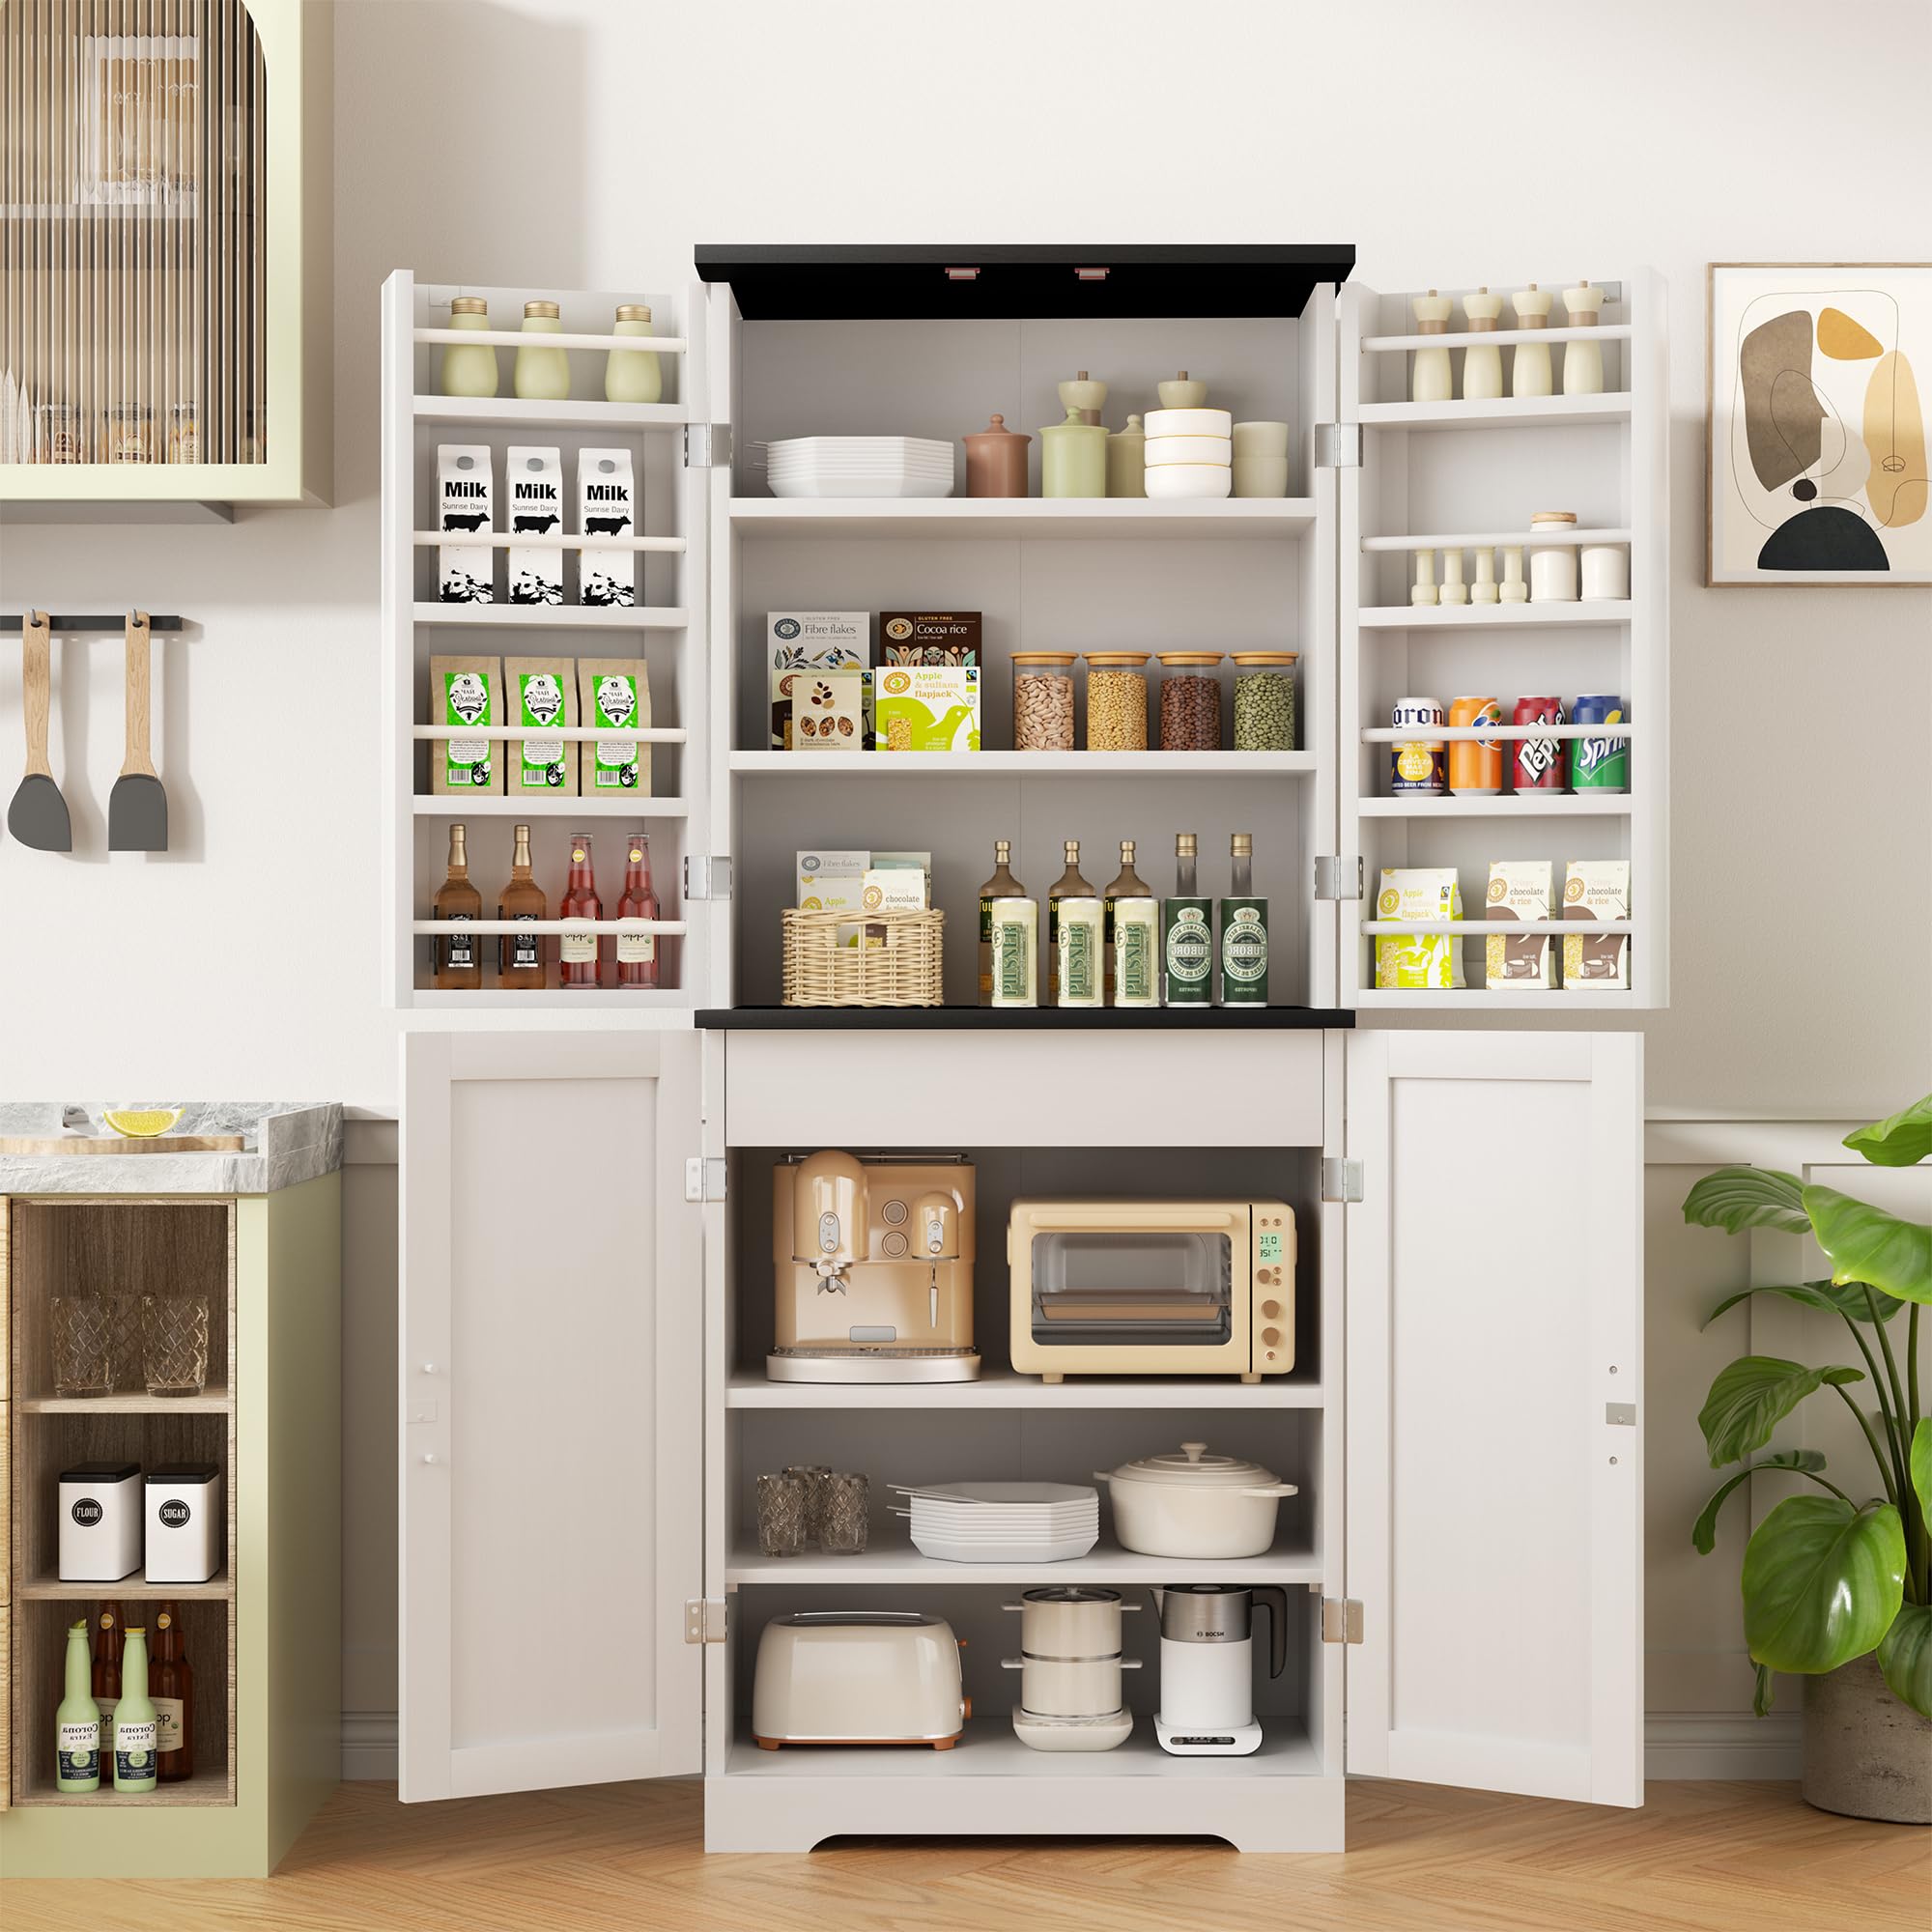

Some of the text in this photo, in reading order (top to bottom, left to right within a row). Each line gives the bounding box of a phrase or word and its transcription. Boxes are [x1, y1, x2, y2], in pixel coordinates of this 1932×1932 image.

[445, 481, 488, 498] Milk
[515, 483, 557, 499] Milk
[586, 485, 629, 501] Milk
[469, 502, 488, 511] Dairy
[512, 503, 558, 513] Sunrise Dairy
[611, 505, 630, 514] Dairy
[805, 623, 857, 635] Fibre flakes
[917, 624, 968, 635] Cocoa rice
[915, 672, 943, 681] Apple
[915, 690, 952, 699] flapjack
[1403, 889, 1423, 898] Apple
[1586, 887, 1622, 895] chocolate
[1004, 925, 1019, 996] PILSNER
[1069, 925, 1085, 996] PILSNER
[1126, 925, 1142, 996] PILSNER
[76, 1507, 99, 1518] FLOUR
[163, 1508, 186, 1519] SUGAR
